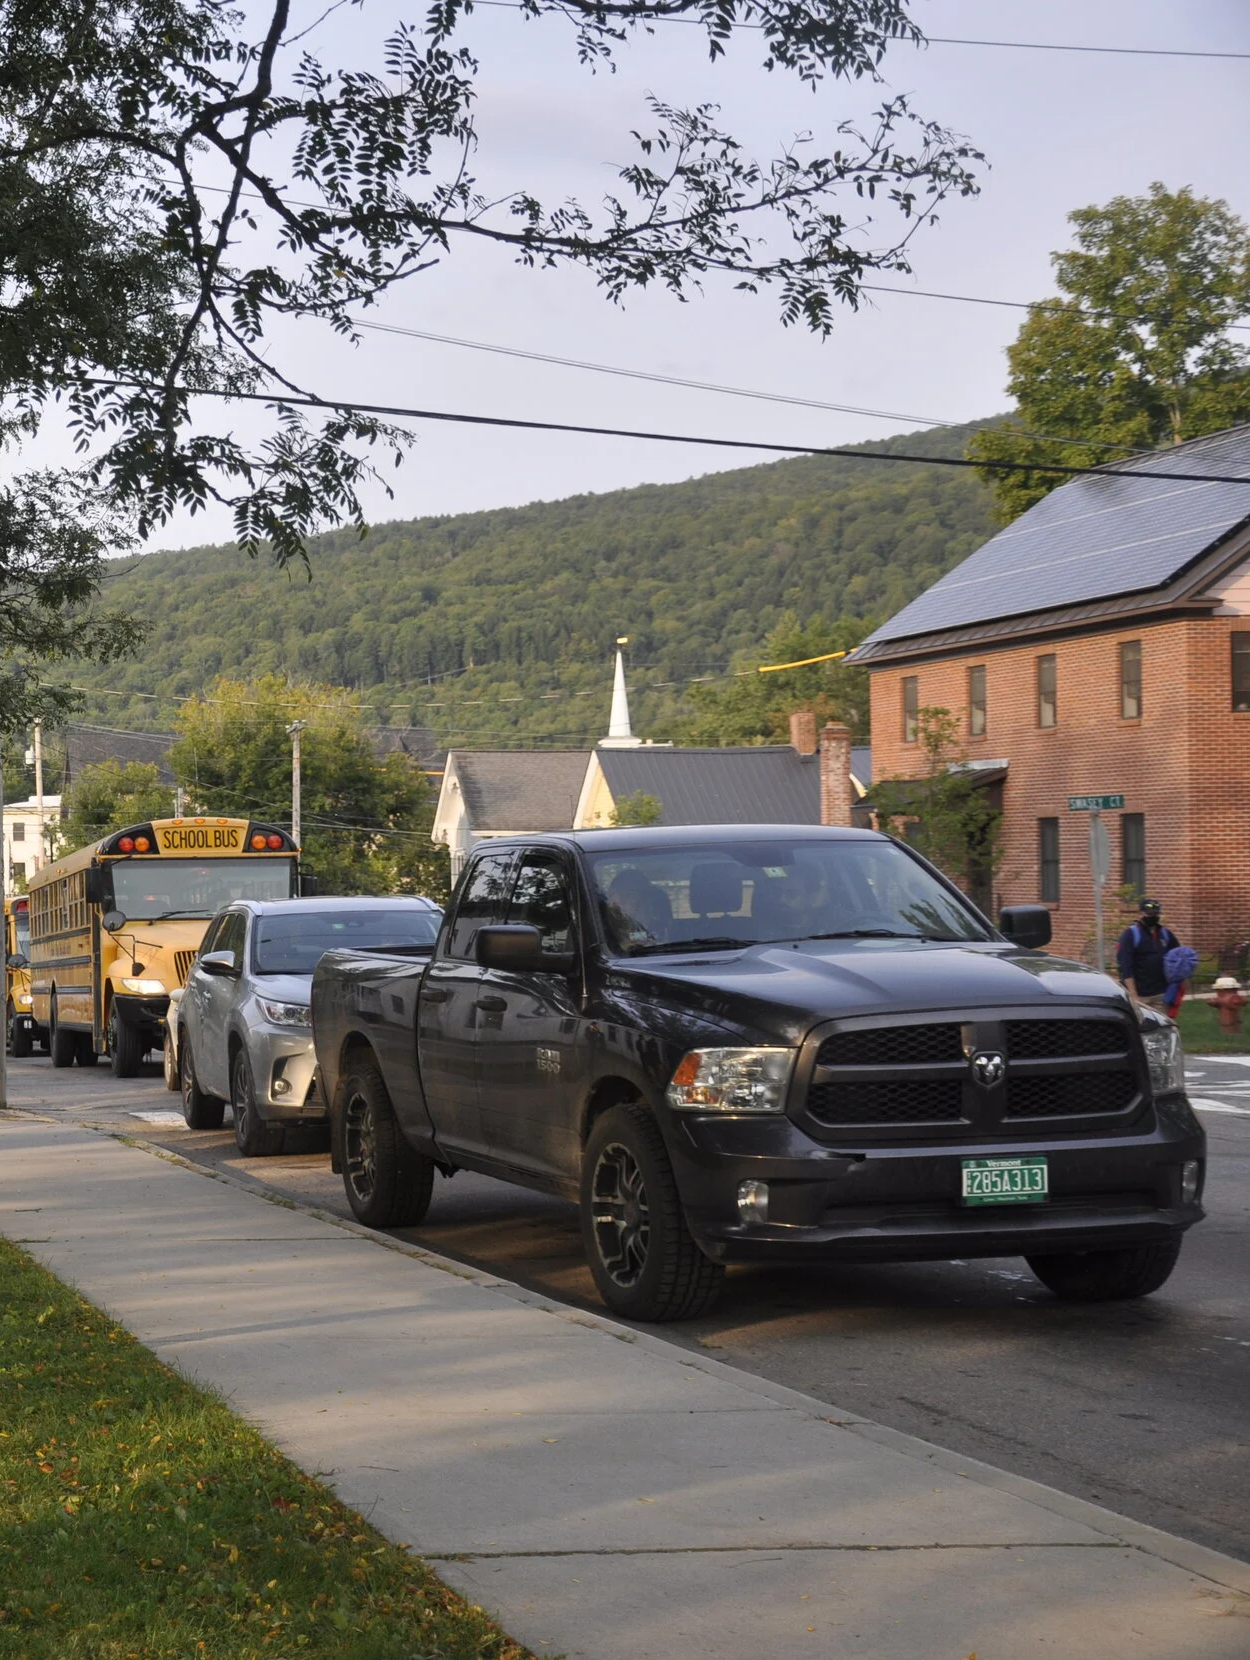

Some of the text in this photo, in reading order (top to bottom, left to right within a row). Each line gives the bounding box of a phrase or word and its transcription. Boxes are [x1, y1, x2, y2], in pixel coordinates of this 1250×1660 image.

[163, 829, 238, 849] SCHOOL BUS
[536, 1059, 561, 1074] 1500
[985, 1159, 1022, 1168] Vermont
[972, 1168, 1043, 1194] 285A313
